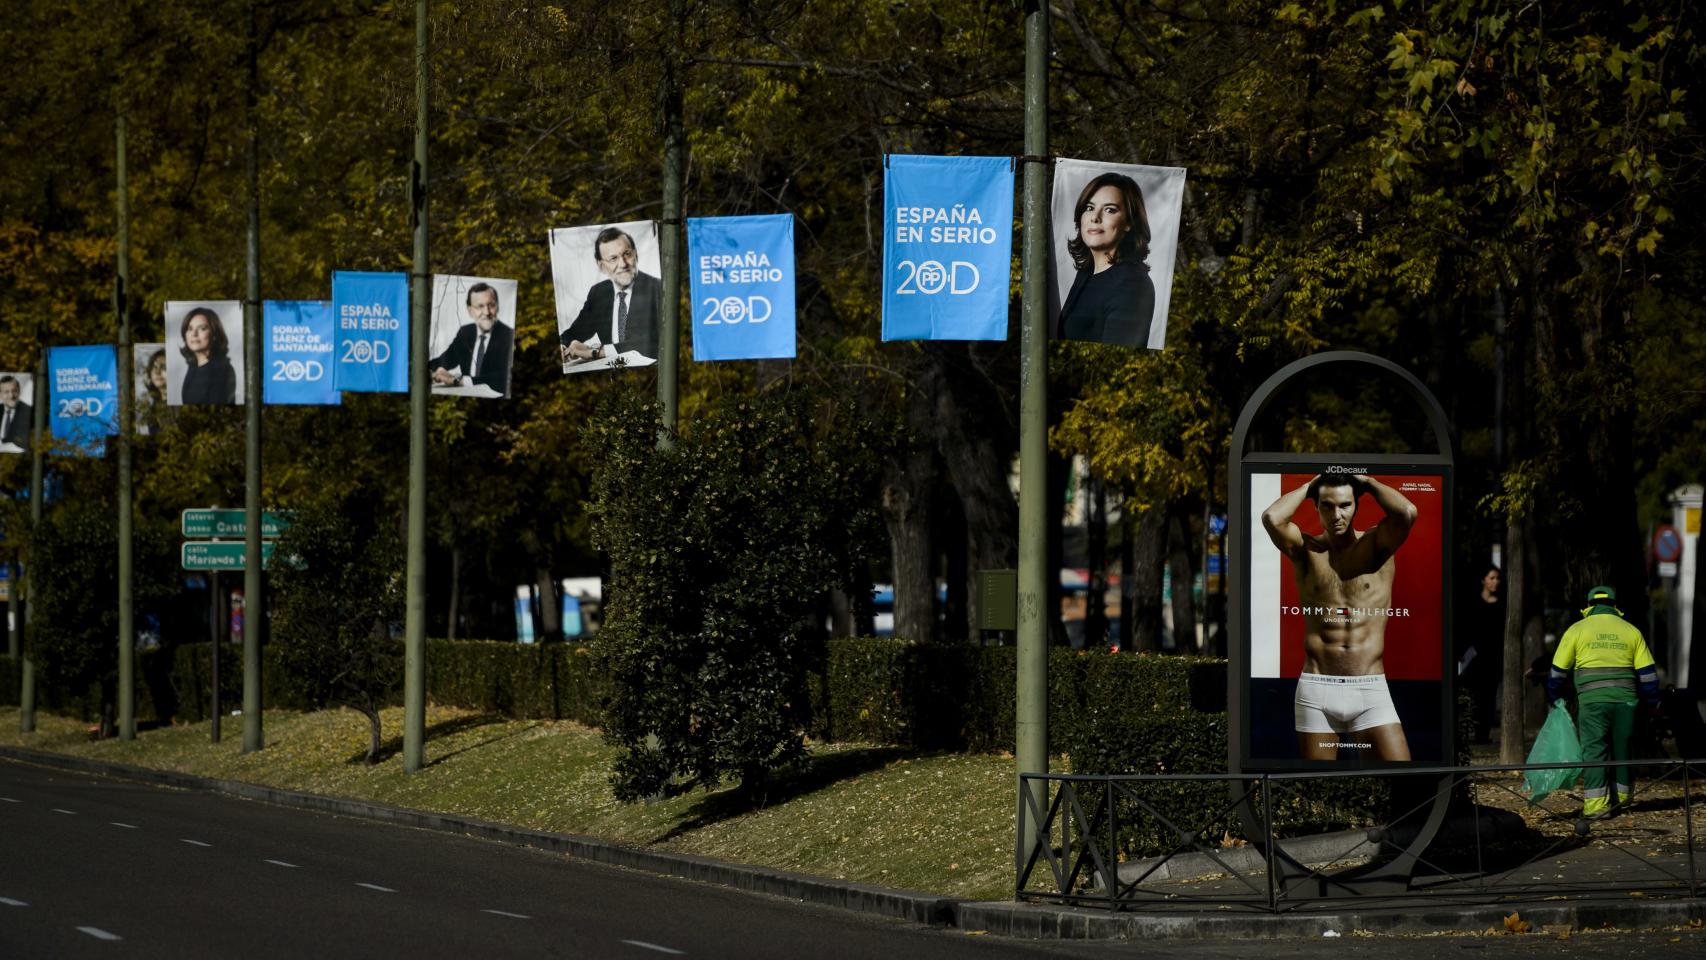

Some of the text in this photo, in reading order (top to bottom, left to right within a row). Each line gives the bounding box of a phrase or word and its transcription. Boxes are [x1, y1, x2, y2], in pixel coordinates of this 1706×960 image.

[896, 203, 982, 224] ESPAÑA
[896, 226, 997, 244] EN SERIO
[700, 251, 770, 269] ESPAÑA
[701, 268, 783, 284] EN SERIO
[340, 303, 391, 317] ESPAÑA
[272, 325, 311, 334] SORAYA
[340, 318, 399, 331] EN SERIO
[306, 334, 321, 343] DE
[1325, 465, 1368, 474] JCDecaux
[186, 513, 215, 521] lateral
[186, 525, 211, 533] paseo
[1281, 606, 1410, 617] TOMMY HILFIGER
